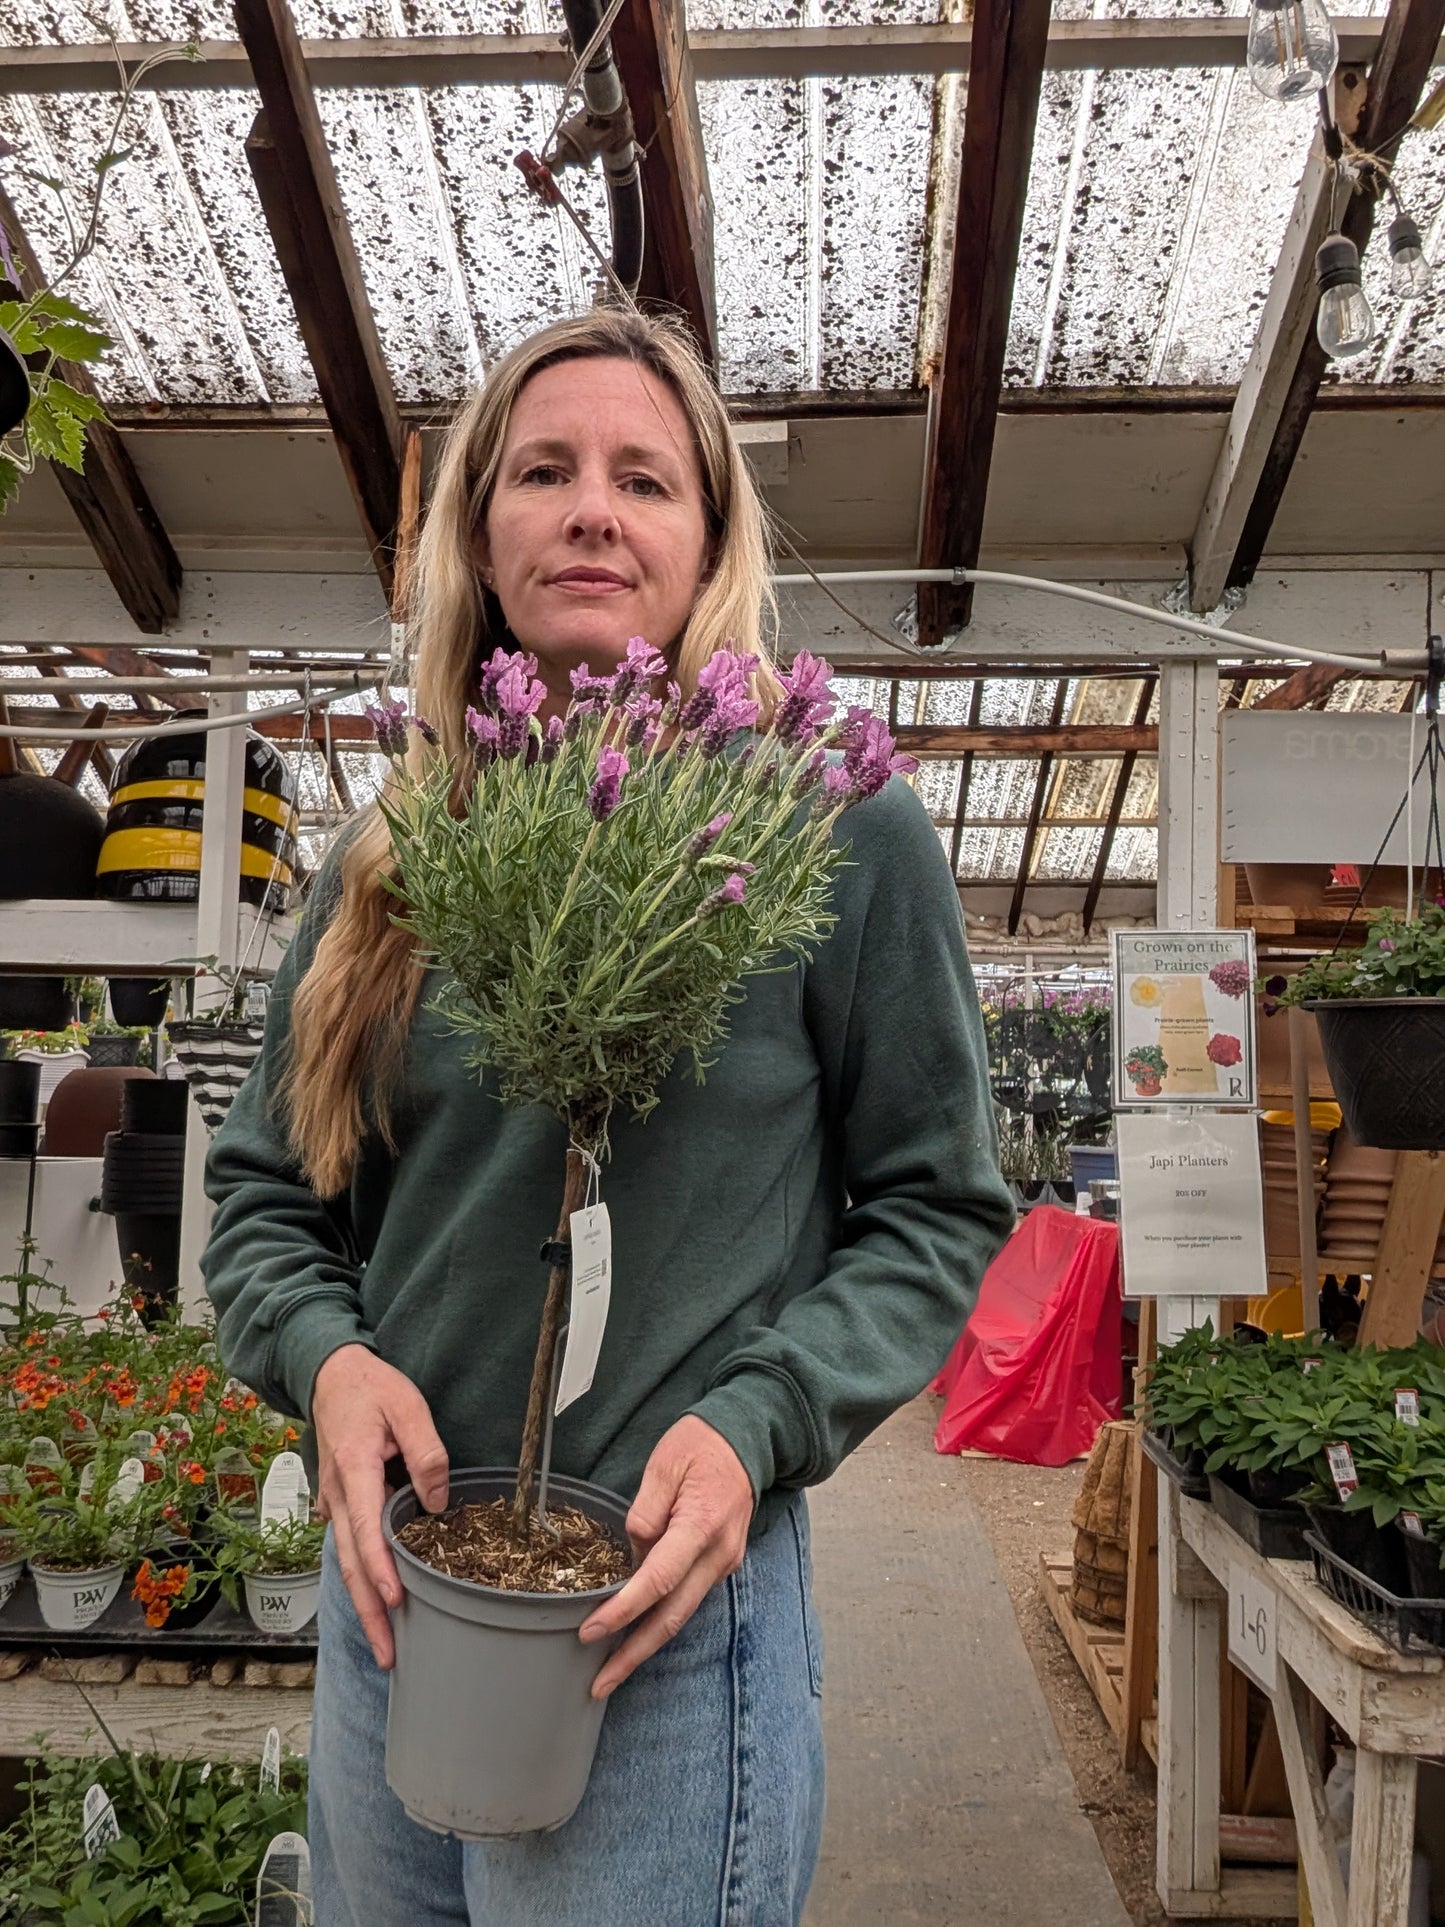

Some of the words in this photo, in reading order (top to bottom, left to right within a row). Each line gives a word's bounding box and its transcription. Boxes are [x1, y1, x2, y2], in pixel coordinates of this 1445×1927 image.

[1133, 941, 1182, 953] Grown
[1187, 943, 1205, 953] on
[1210, 940, 1233, 953] the
[1154, 959, 1209, 971] Prairies
[1149, 1155, 1174, 1170] Japi
[1178, 1155, 1229, 1167] Planters
[1191, 1189, 1207, 1197] OFF
[1240, 1594, 1267, 1655] 1-6
